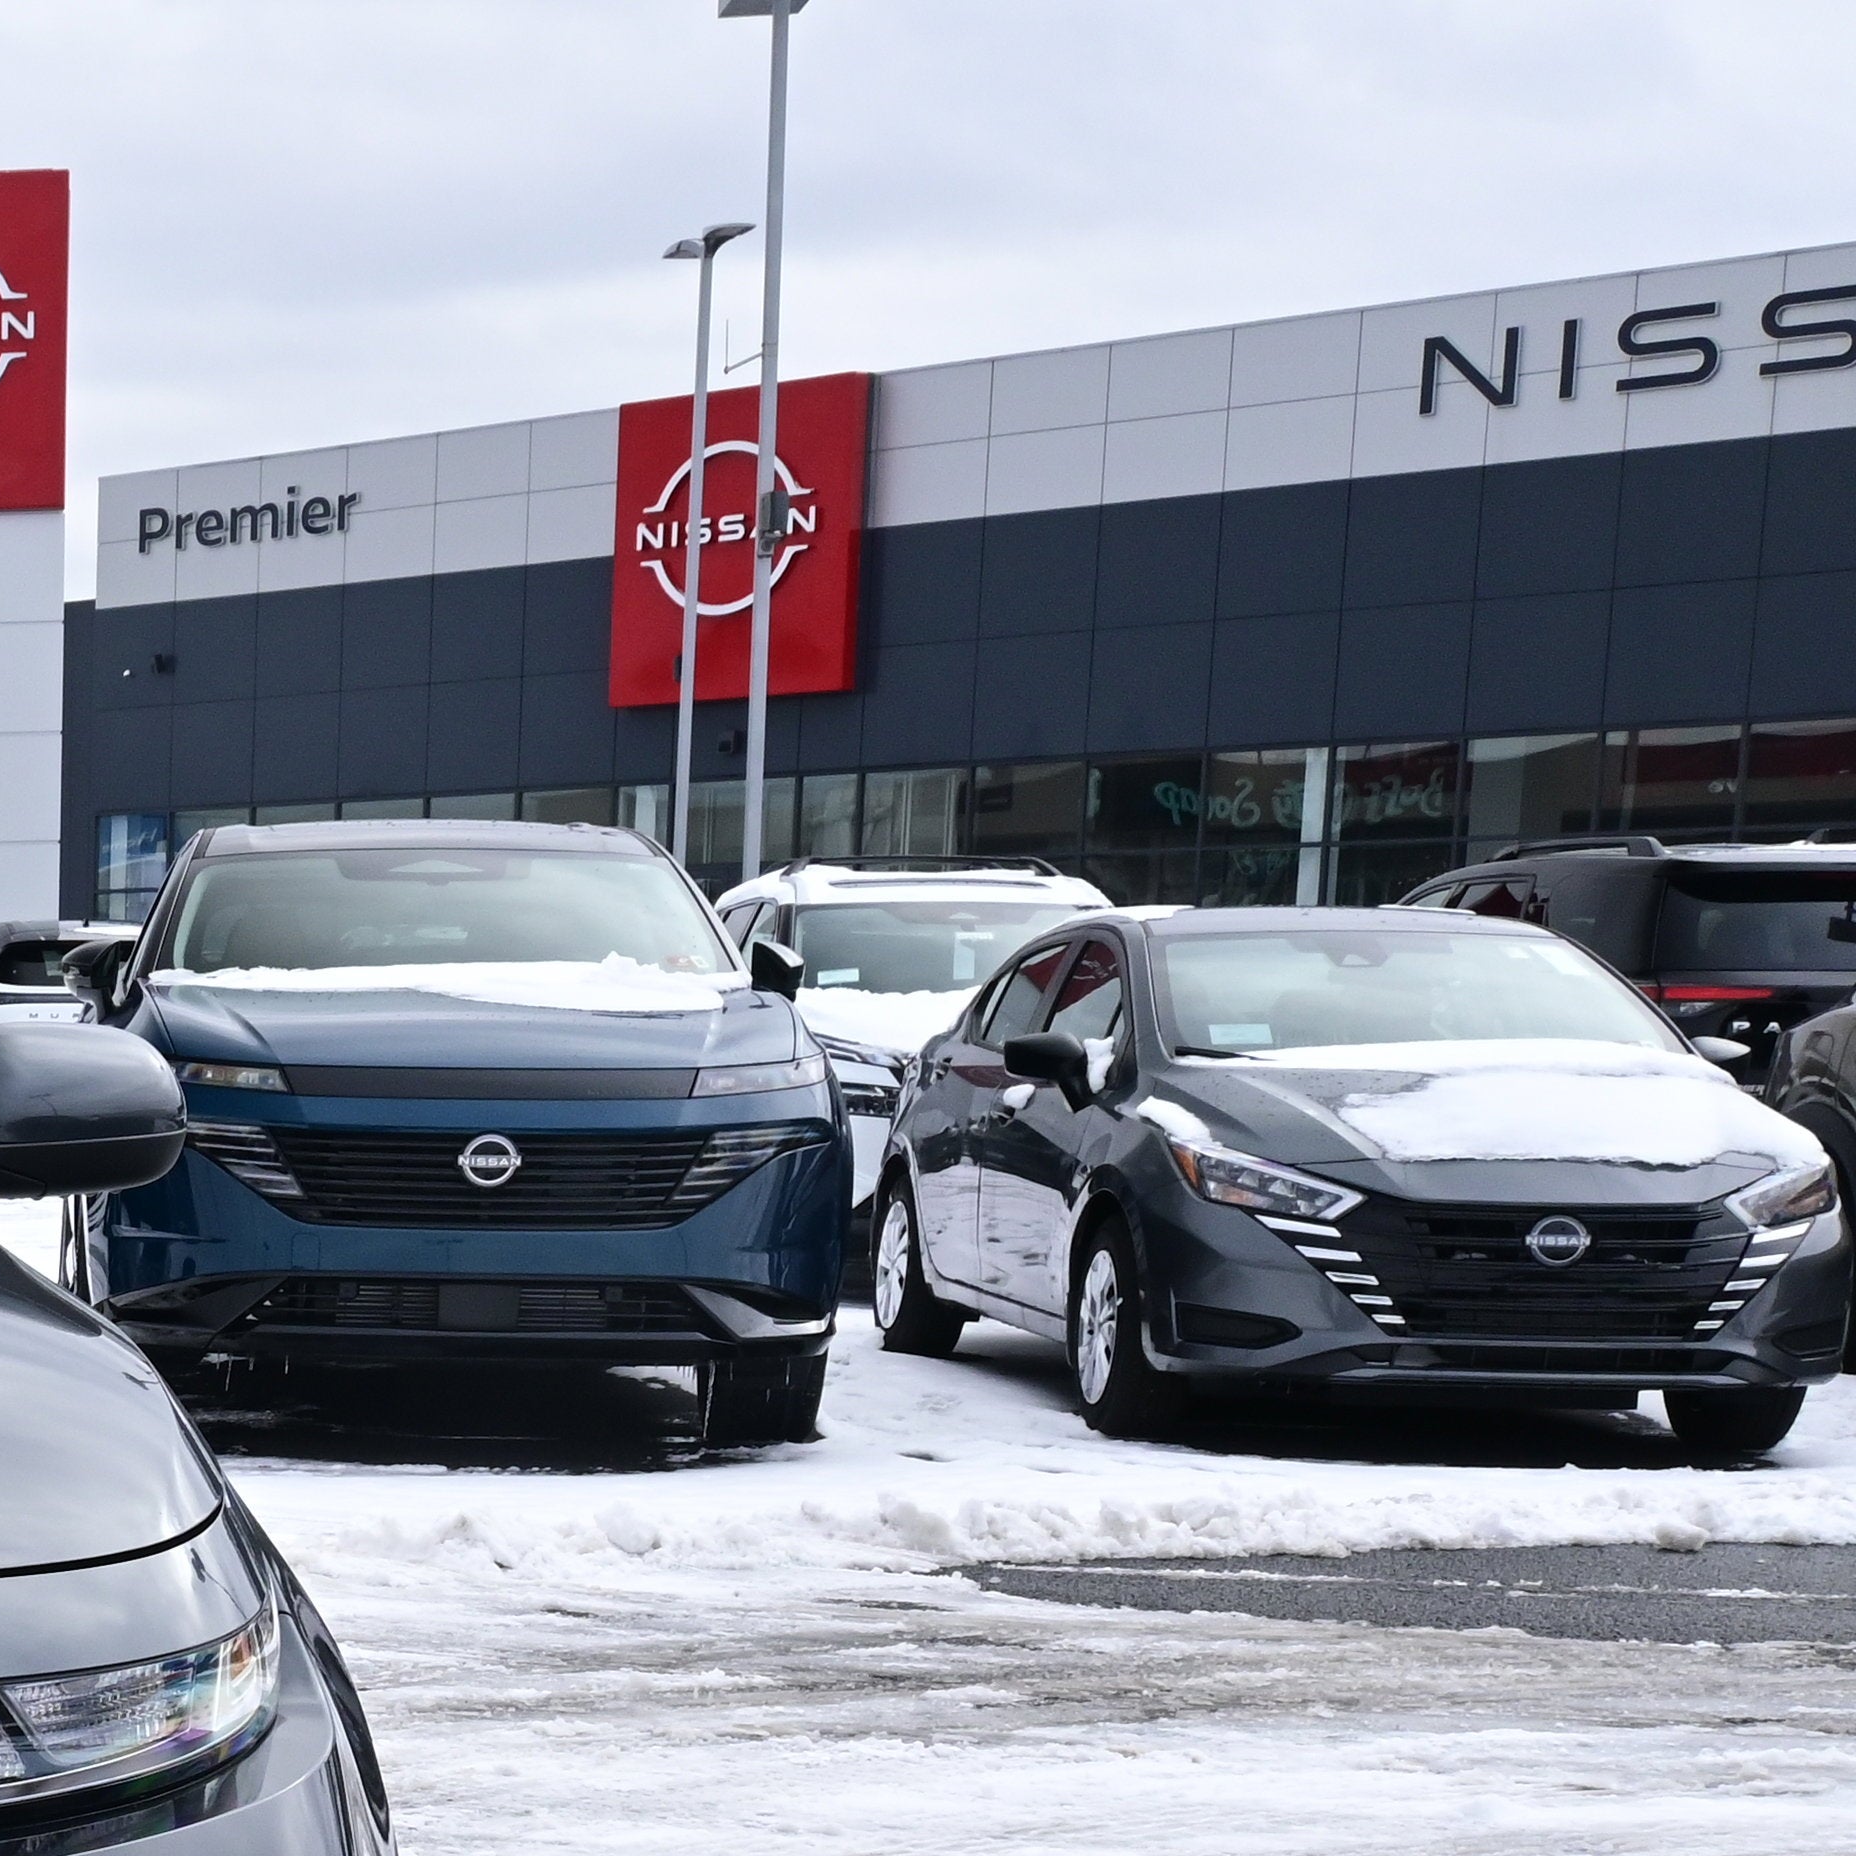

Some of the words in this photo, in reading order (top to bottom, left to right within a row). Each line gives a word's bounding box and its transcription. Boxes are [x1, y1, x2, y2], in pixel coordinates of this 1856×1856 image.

[139, 486, 359, 554] Premier
[635, 504, 817, 552] NISSN
[458, 1155, 522, 1168] NISSAN
[1525, 1234, 1591, 1247] NISSAN
